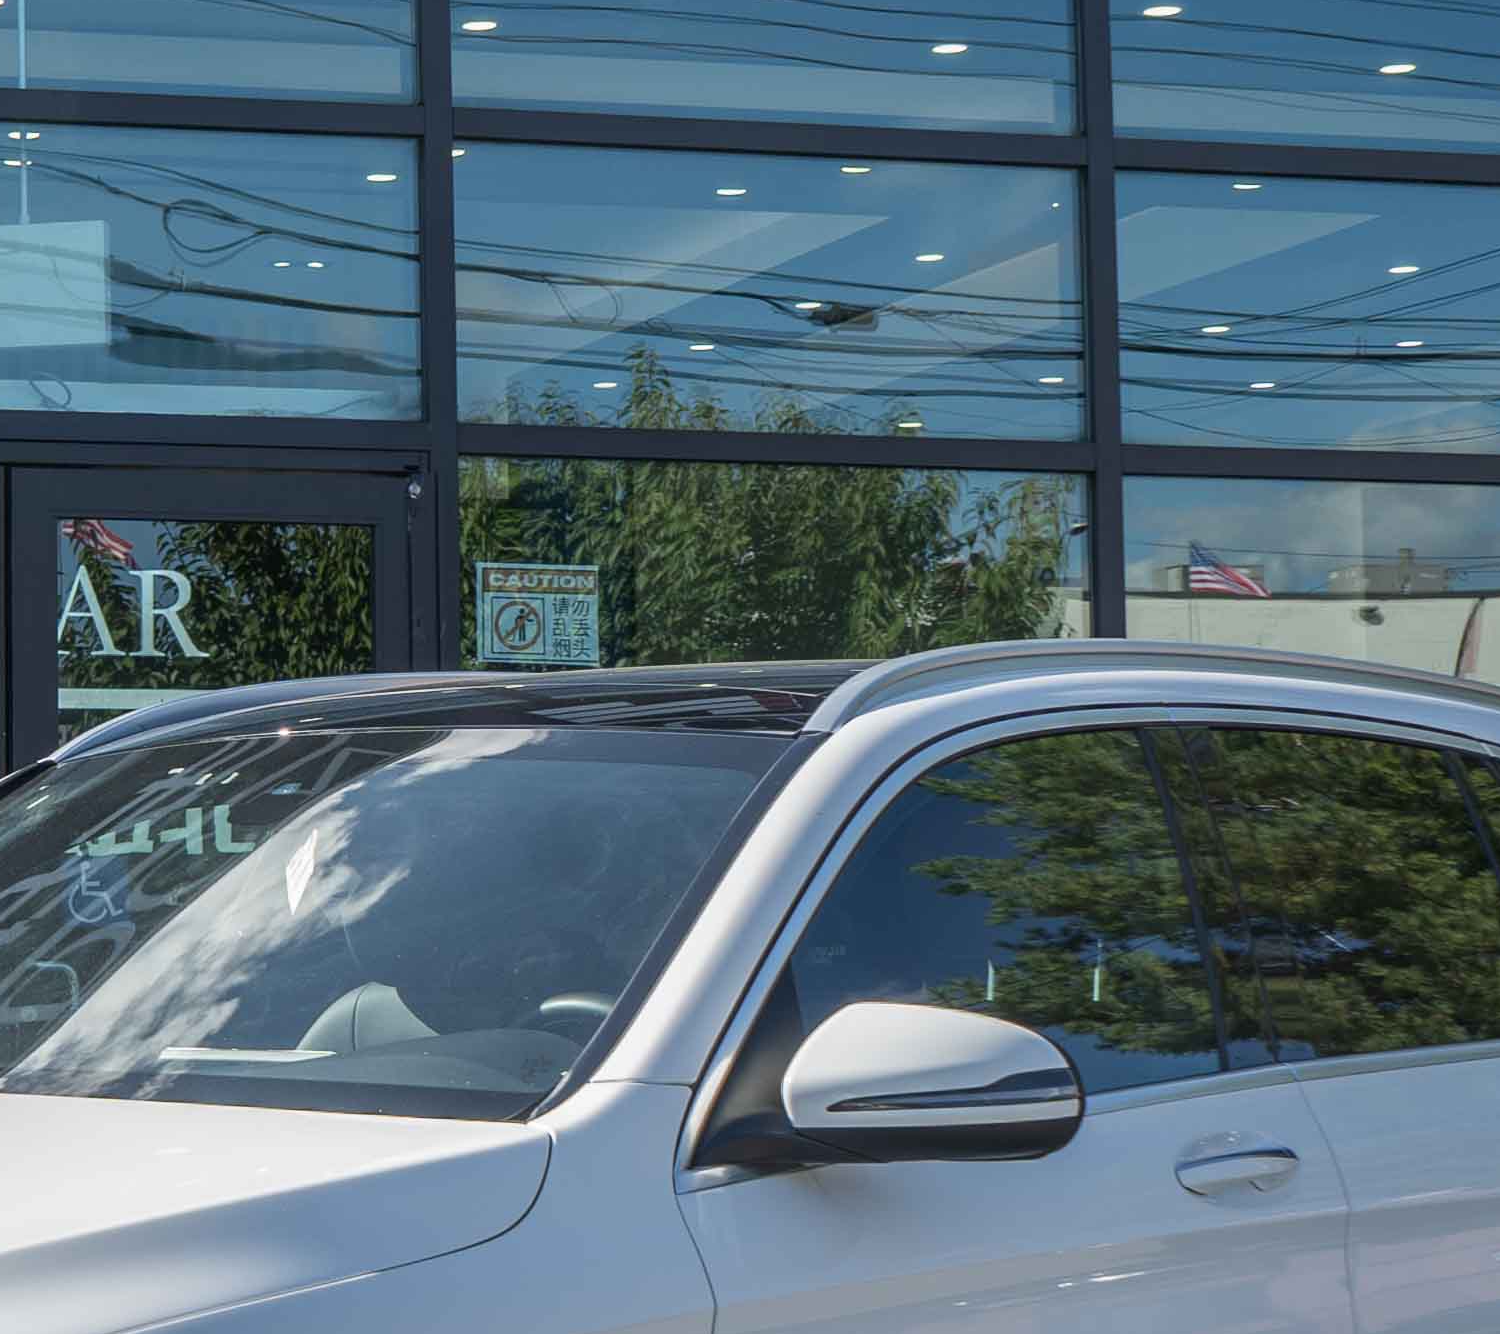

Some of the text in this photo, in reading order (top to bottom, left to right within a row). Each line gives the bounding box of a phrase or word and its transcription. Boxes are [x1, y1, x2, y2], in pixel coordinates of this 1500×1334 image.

[487, 572, 596, 589] CAUTION
[56, 564, 211, 658] AR
[551, 596, 591, 617] 请勿
[551, 618, 592, 638] 乱丢
[551, 638, 592, 659] 烟头
